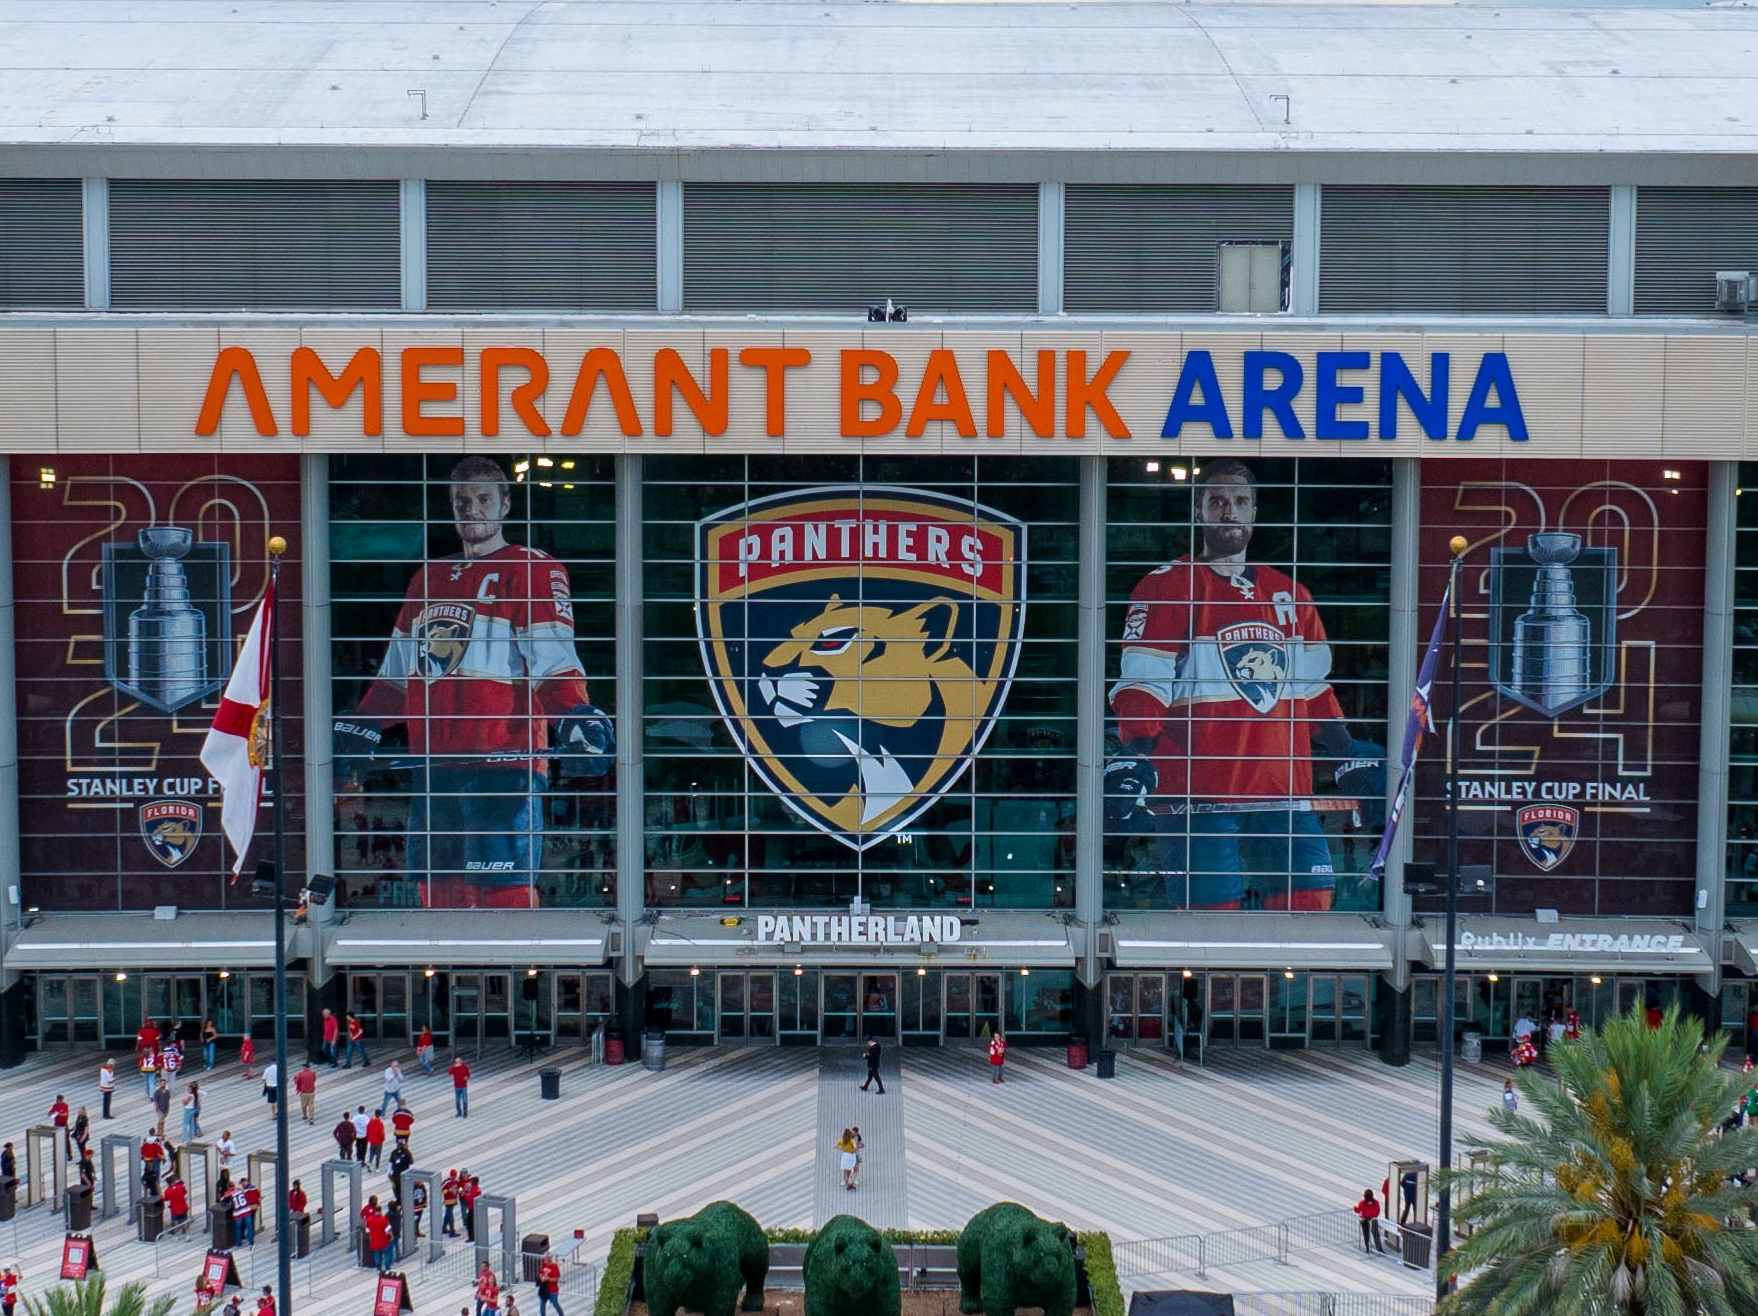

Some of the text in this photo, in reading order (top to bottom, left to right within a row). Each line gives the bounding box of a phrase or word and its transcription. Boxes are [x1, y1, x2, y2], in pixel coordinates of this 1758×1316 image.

[194, 346, 1530, 442] AMERANT BANK ARENA
[738, 518, 984, 578] PANTHERS
[477, 572, 500, 604] C
[420, 605, 471, 623] PANTHERS
[1272, 591, 1298, 626] A
[1225, 627, 1285, 644] PANTHERS
[66, 778, 157, 796] STANLEY
[162, 778, 203, 796] CUP
[1540, 781, 1580, 801] CUP
[1584, 782, 1651, 803] FINAL
[147, 805, 196, 819] FLORIDA
[1523, 811, 1572, 823] FLORIDA
[465, 861, 515, 871] BAUER
[758, 915, 961, 942] PANTHERLAND
[1461, 931, 1684, 952] Publix ENTRANCE
